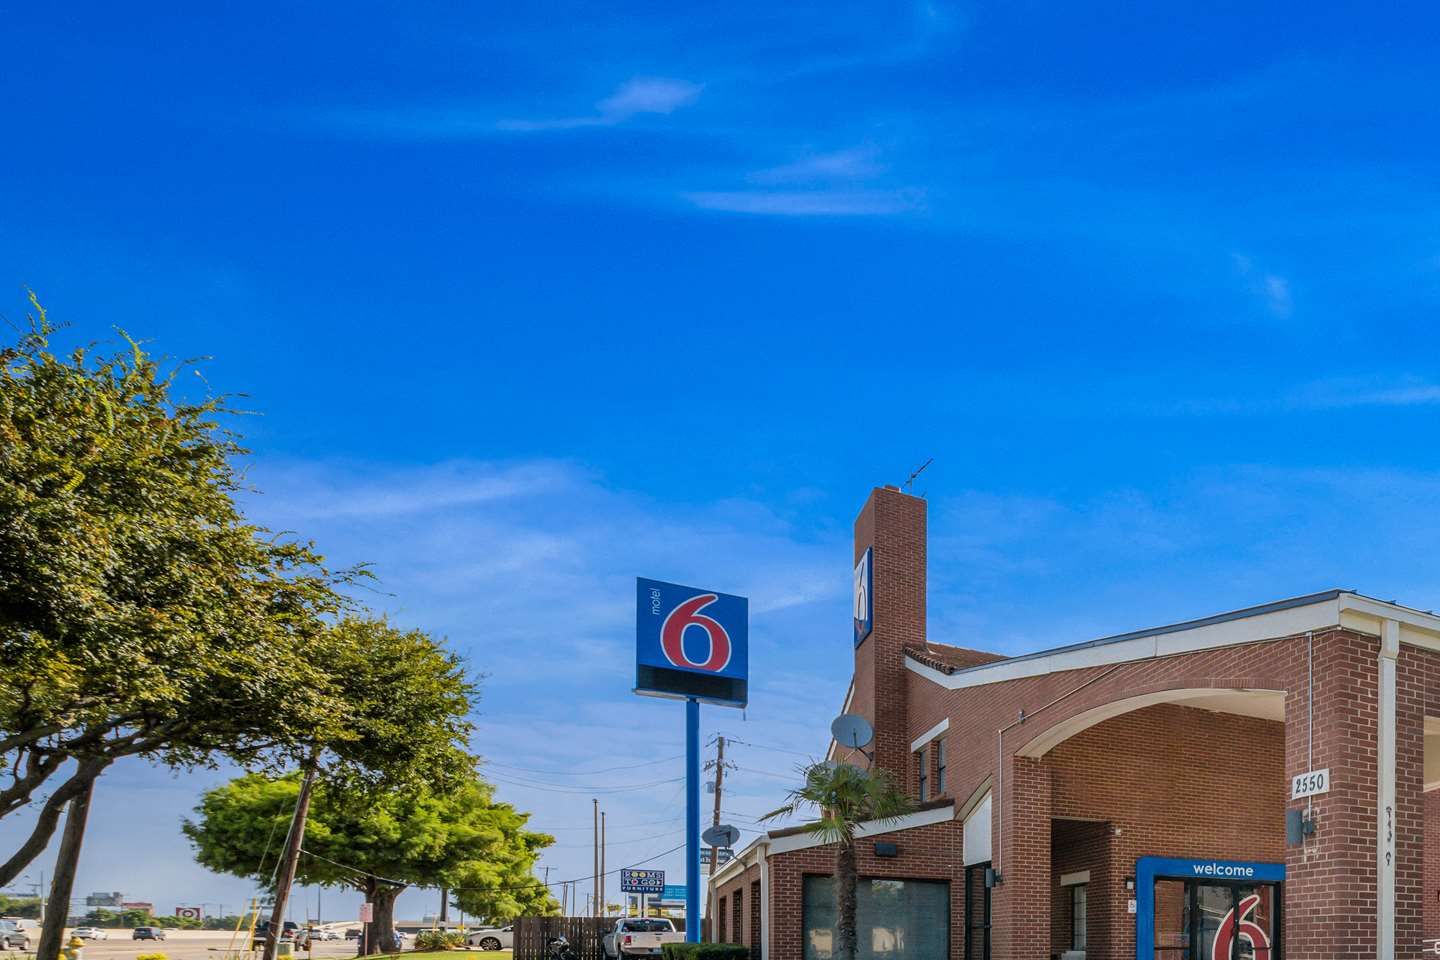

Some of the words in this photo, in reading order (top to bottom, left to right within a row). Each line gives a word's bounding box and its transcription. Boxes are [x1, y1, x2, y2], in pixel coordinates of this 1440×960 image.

[650, 587, 661, 615] motel
[660, 593, 732, 673] 6
[1295, 773, 1324, 794] 2550
[624, 870, 663, 879] ROOMS
[1193, 863, 1254, 877] welcome
